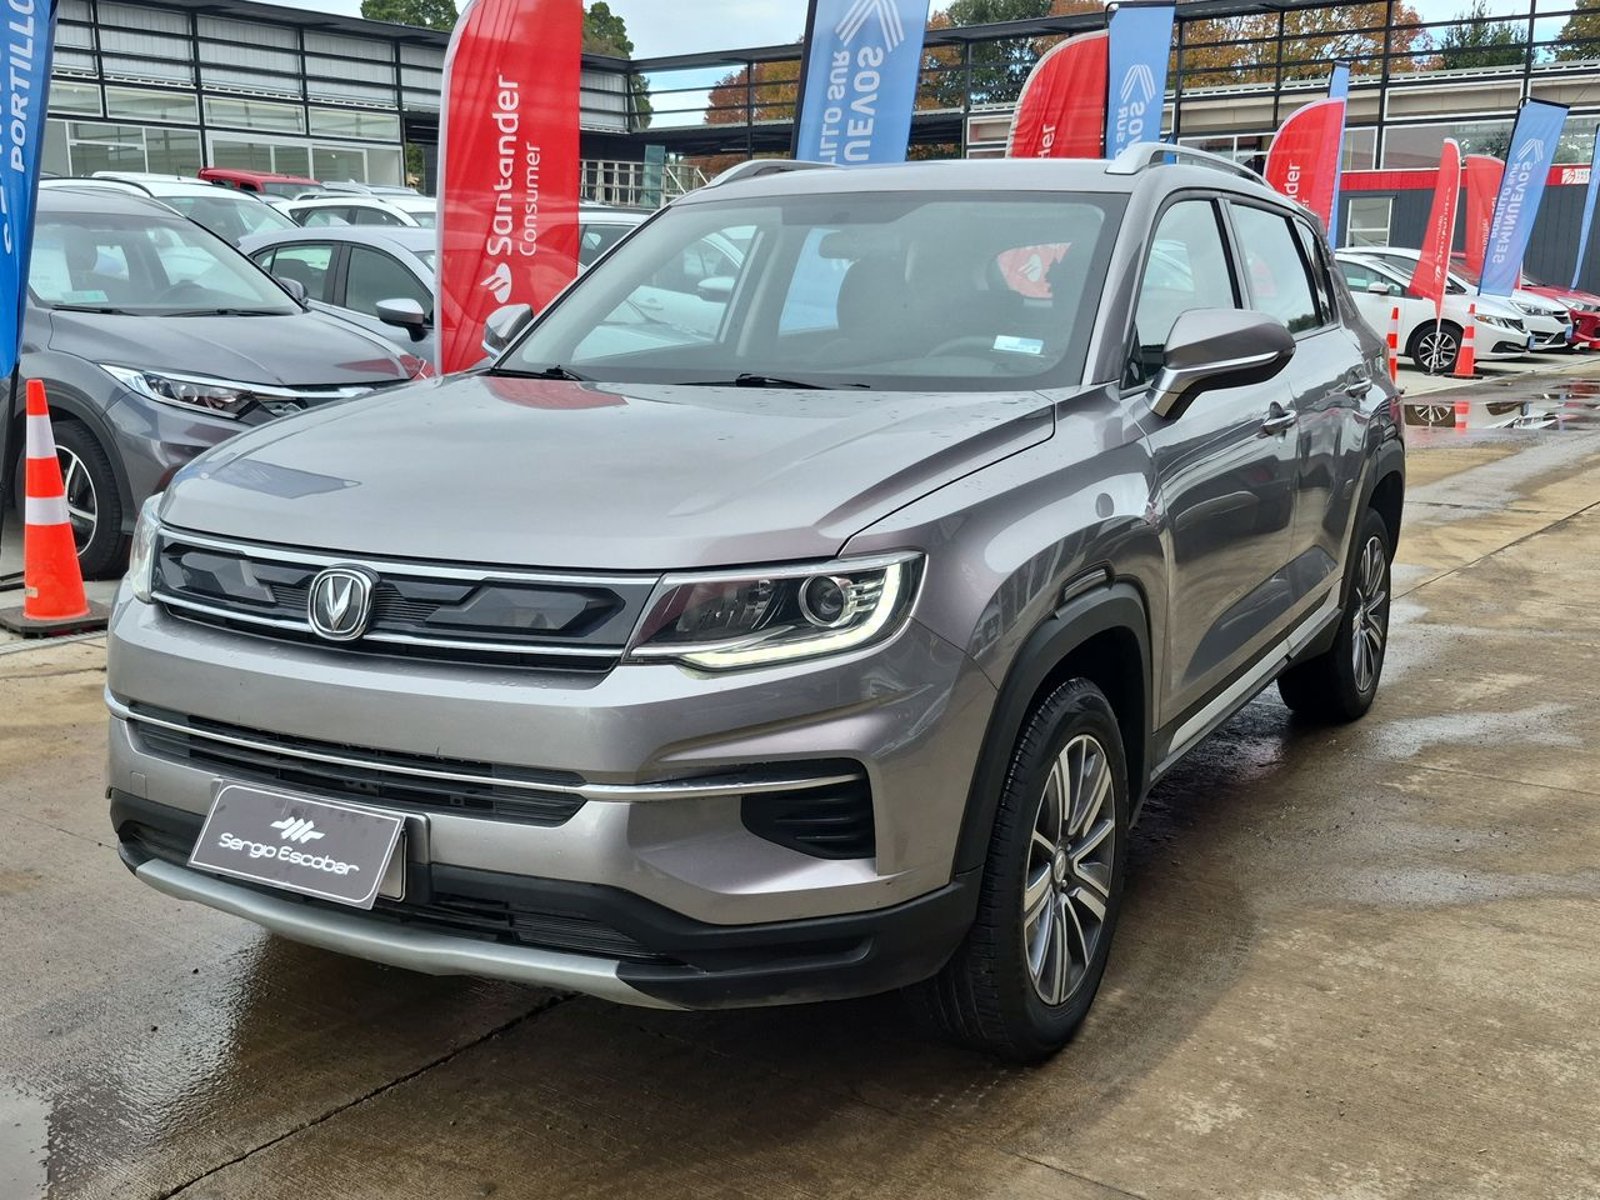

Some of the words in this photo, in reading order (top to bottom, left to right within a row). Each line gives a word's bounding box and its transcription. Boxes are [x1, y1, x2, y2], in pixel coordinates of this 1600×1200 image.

[487, 75, 519, 256] Santander
[519, 142, 541, 256] Consumer
[218, 832, 277, 858] Sergio
[278, 845, 360, 876] Escobar
